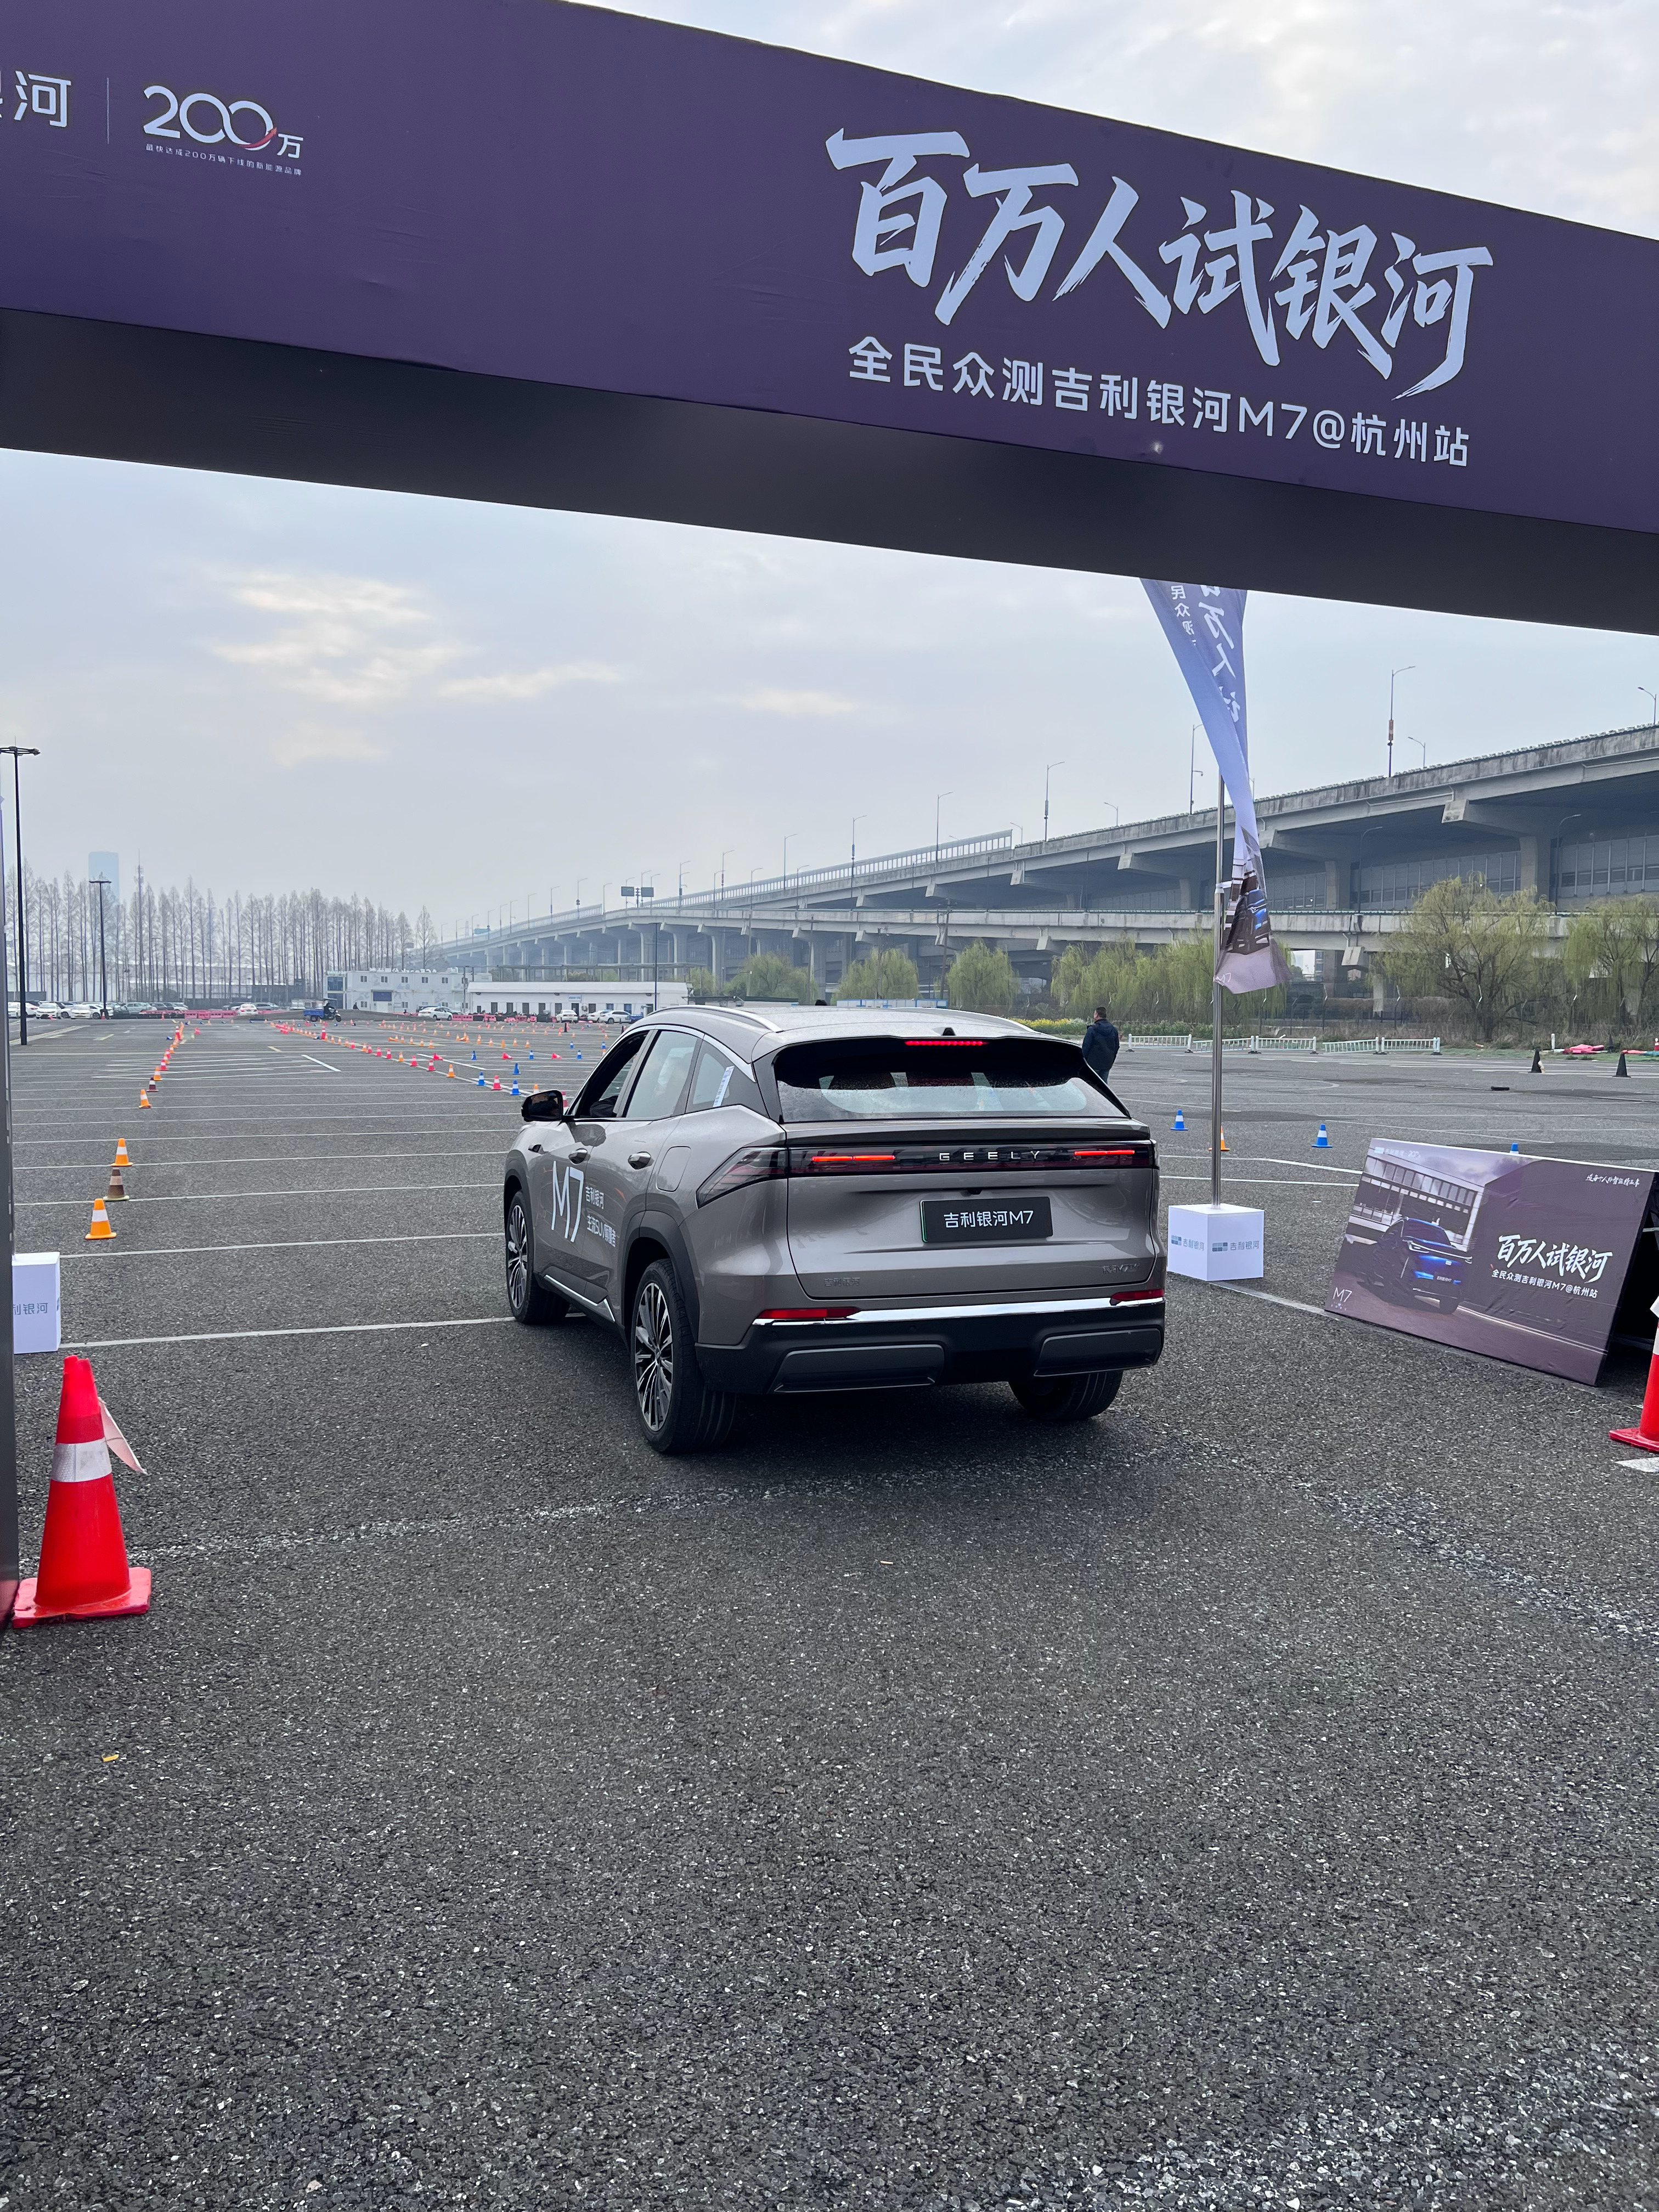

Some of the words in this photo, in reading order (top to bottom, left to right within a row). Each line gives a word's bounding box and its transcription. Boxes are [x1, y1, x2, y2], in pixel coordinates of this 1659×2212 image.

[0, 71, 71, 127] 河
[825, 127, 1493, 400] 百万人试银河
[849, 336, 1469, 467] 全民众测吉利银河M7@杭州站
[939, 1150, 1040, 1161] GEELY
[551, 1160, 584, 1243] M7
[943, 1210, 1034, 1228] 吉利银河M7
[1183, 1238, 1205, 1251] 吉利银河
[1230, 1240, 1260, 1251] 吉利银河
[1497, 1234, 1613, 1284] 百万人试银河
[1333, 1286, 1353, 1303] M7
[1491, 1269, 1598, 1299] 全民众测吉利银河M7@杭州站
